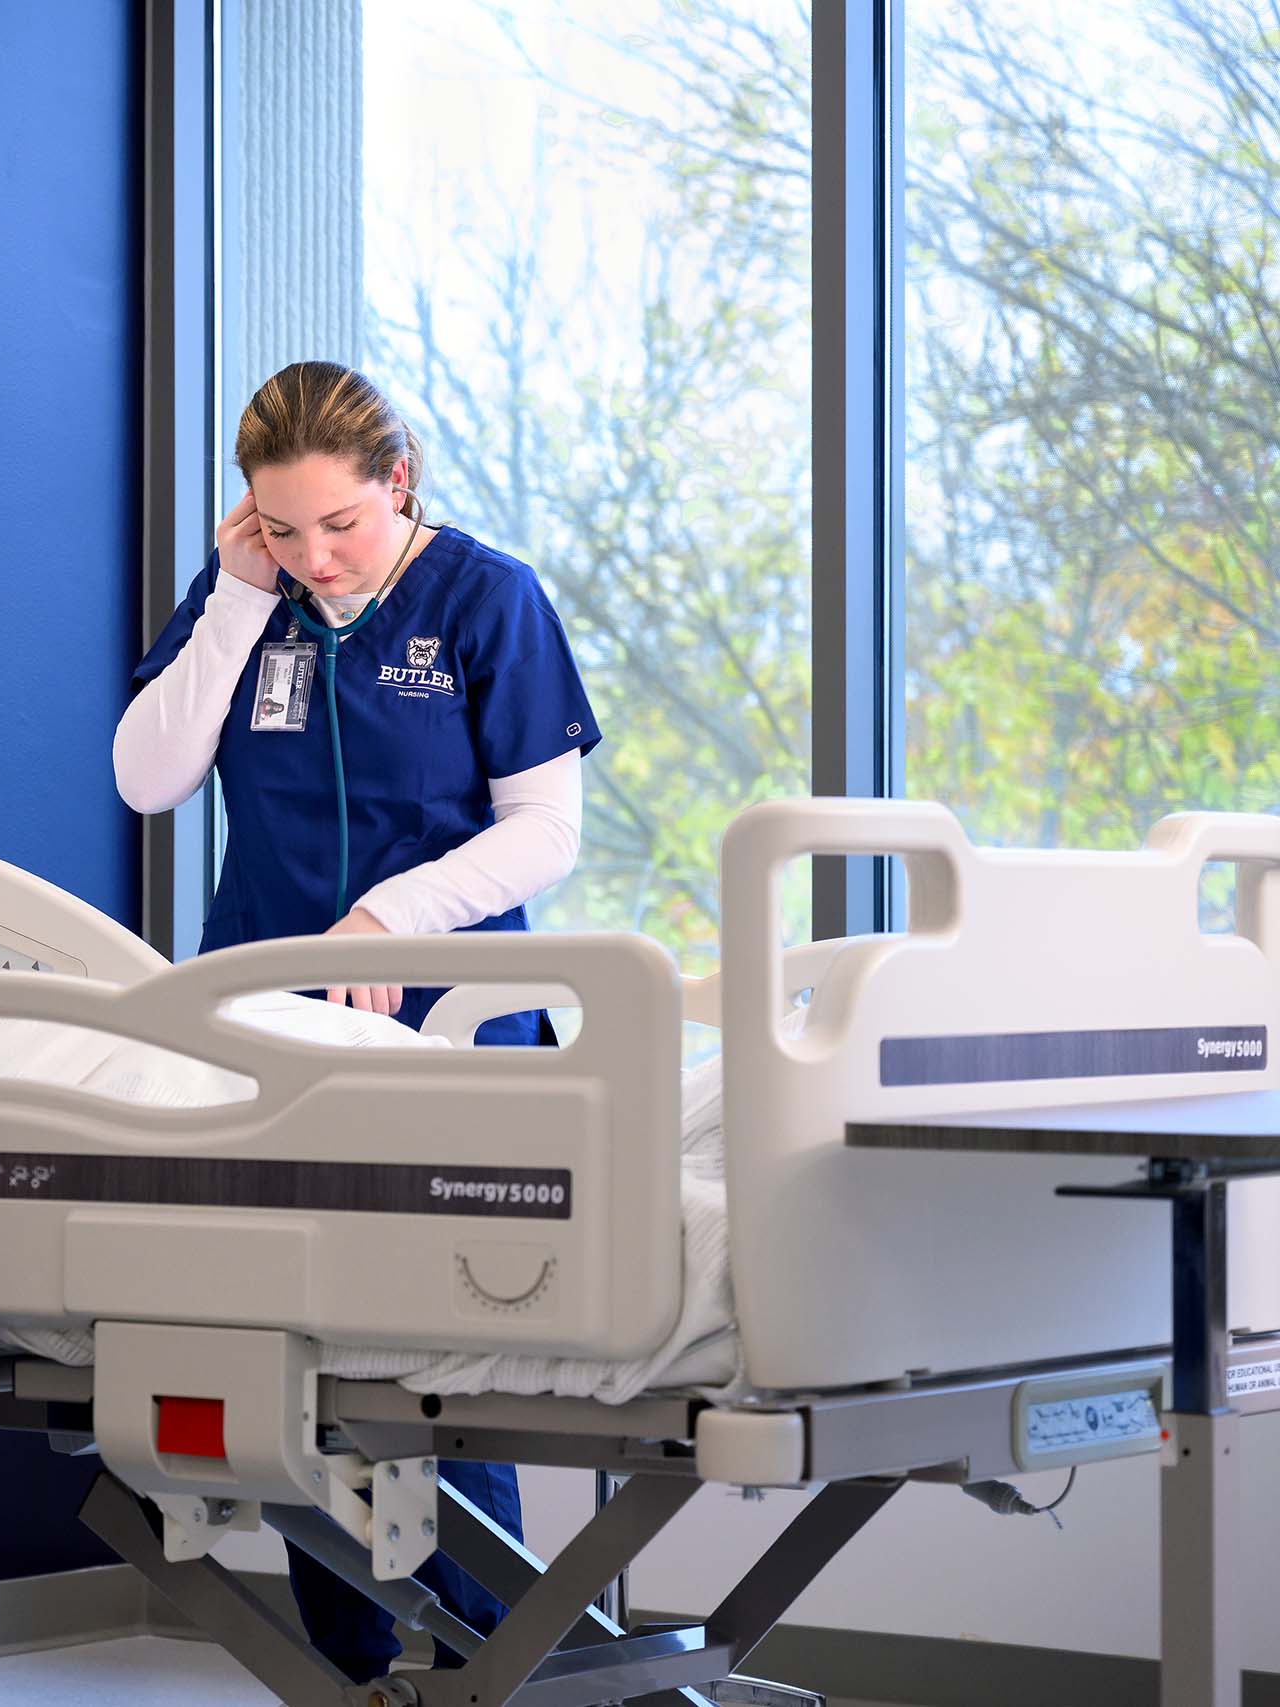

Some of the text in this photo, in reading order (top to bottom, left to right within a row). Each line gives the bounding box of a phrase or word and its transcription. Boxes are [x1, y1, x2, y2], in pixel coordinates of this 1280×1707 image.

[295, 660, 306, 690] BUTLER
[378, 665, 455, 691] BUTLER
[398, 690, 430, 699] NURSING
[1197, 1038, 1263, 1058] Synergy5000
[429, 1176, 565, 1204] Synergy5000
